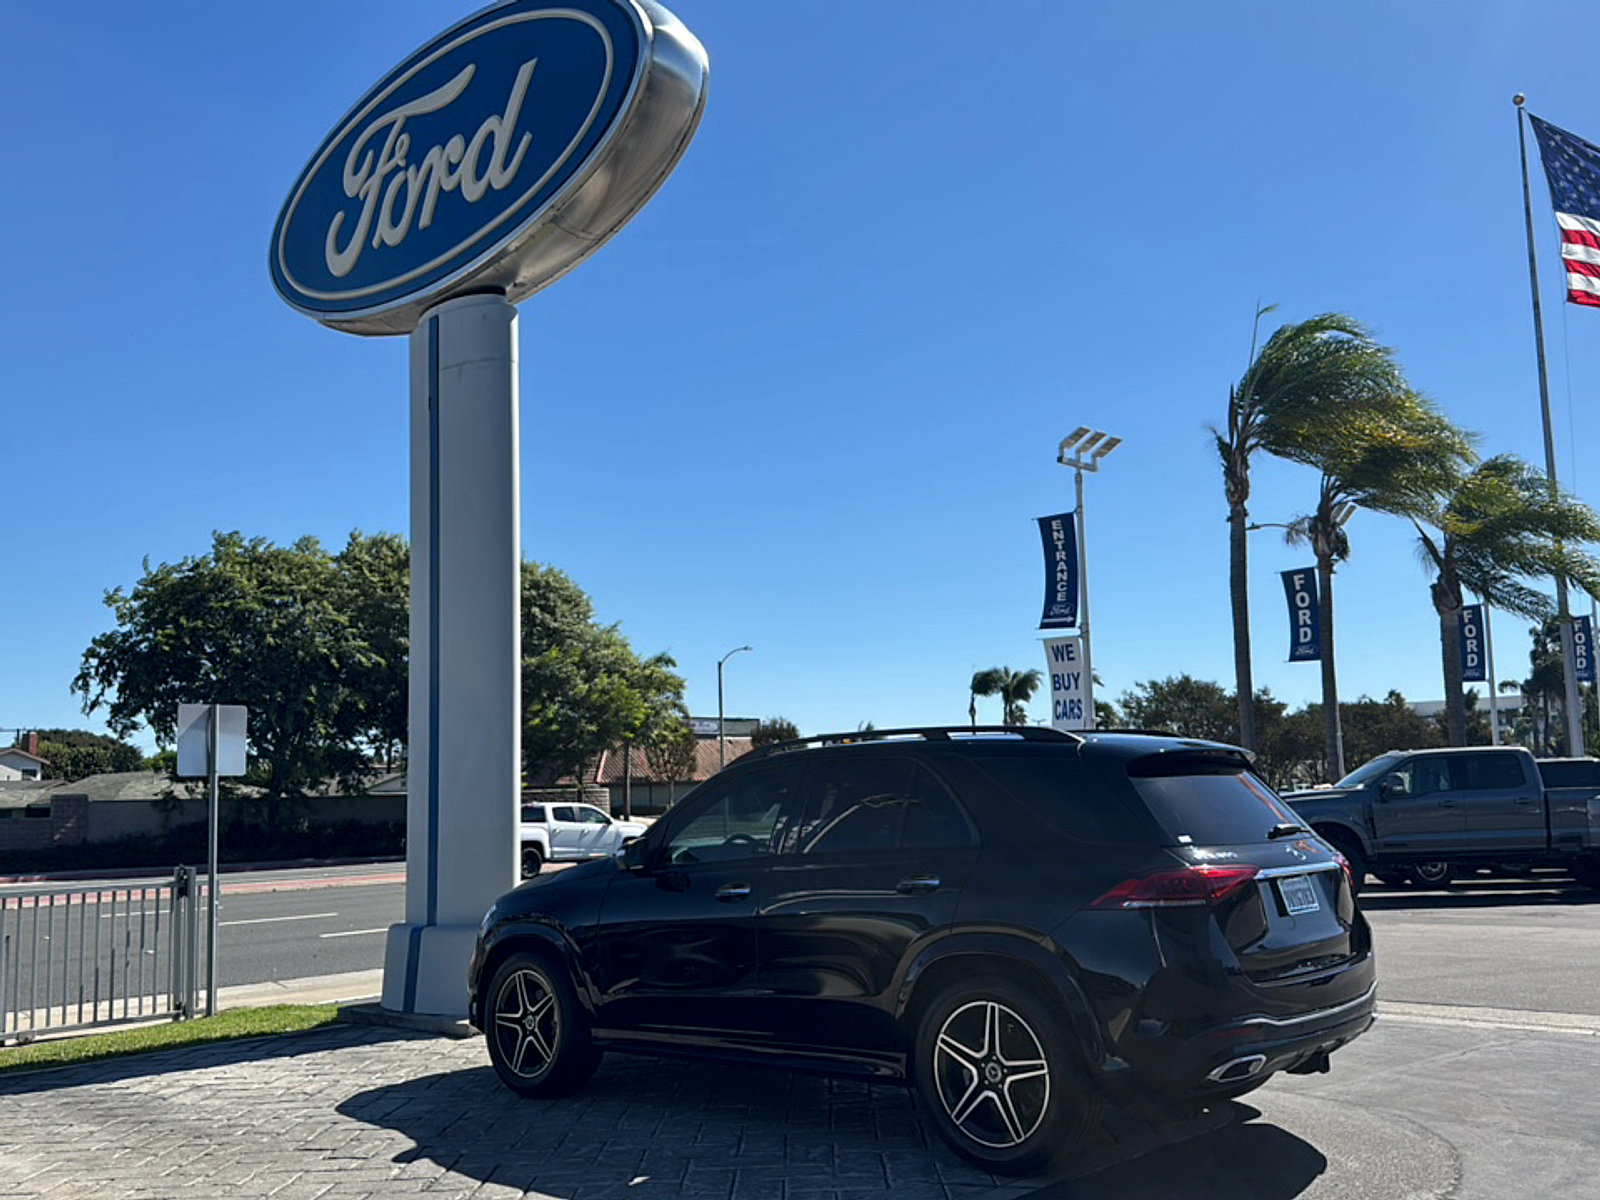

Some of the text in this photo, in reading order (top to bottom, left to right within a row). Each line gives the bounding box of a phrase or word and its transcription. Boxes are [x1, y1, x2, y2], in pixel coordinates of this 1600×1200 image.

[325, 56, 539, 278] Ford
[1051, 519, 1067, 602] ENTRANCE
[1293, 574, 1312, 643] FORD
[1051, 643, 1076, 662] WE
[1463, 609, 1478, 668] FORD
[1573, 619, 1587, 669] FORD
[1053, 672, 1082, 691] BUY
[1054, 699, 1083, 721] CARS
